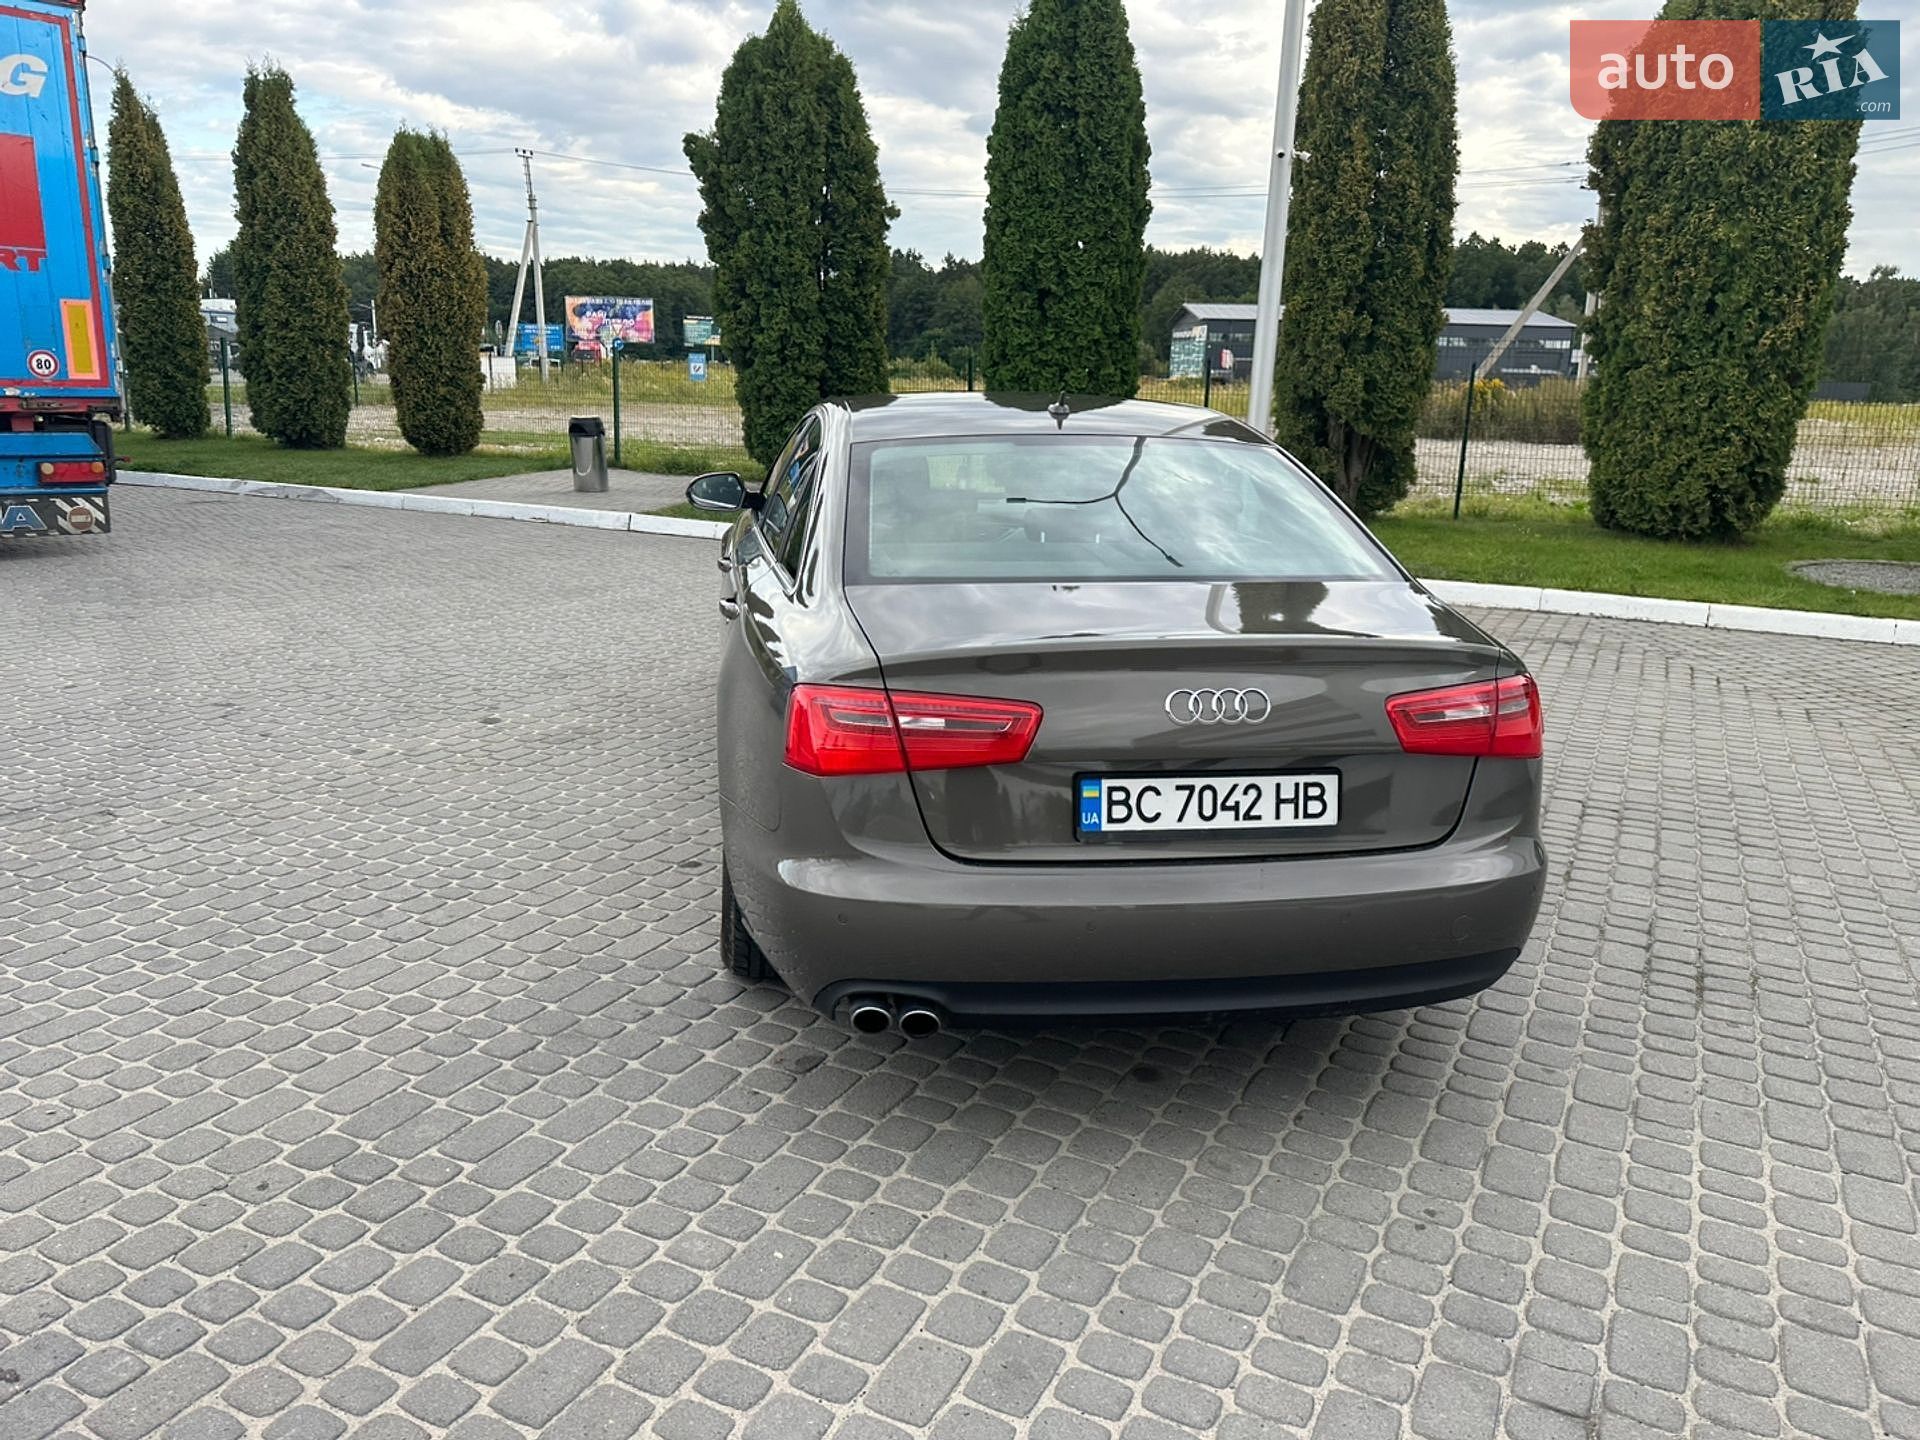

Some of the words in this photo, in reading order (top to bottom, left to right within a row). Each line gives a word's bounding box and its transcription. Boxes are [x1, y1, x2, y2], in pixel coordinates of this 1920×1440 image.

[35, 358, 52, 371] 80
[1106, 785, 1162, 824] BC
[1175, 783, 1262, 823] 7042
[1275, 781, 1328, 821] HB
[1082, 812, 1099, 824] UA
